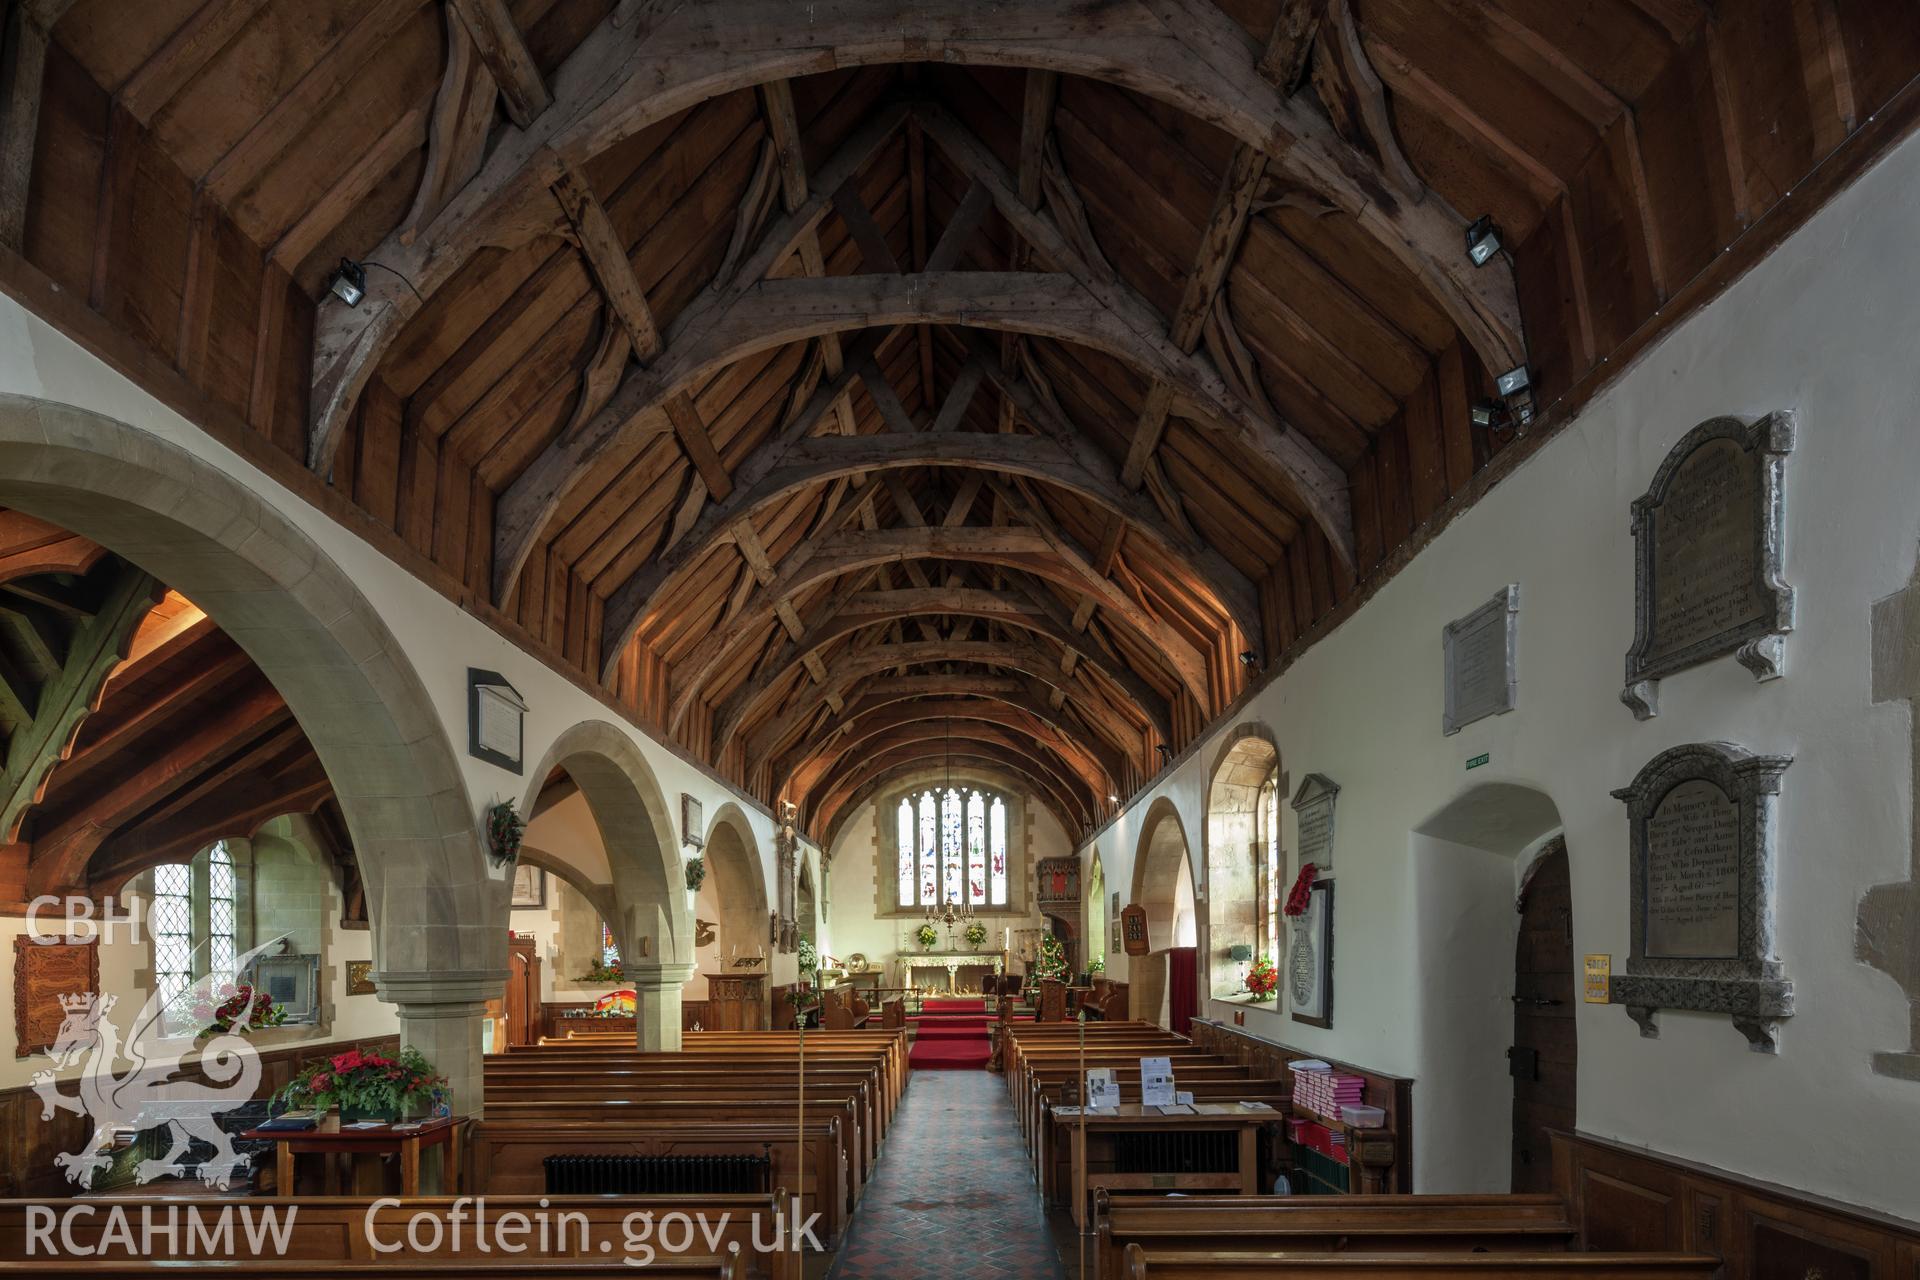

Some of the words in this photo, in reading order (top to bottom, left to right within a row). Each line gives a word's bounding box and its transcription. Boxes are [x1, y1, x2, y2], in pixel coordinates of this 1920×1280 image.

[1663, 804, 1671, 815] In
[1673, 800, 1707, 815] Memory
[1671, 858, 1689, 869] Who
[1692, 853, 1728, 869] Departed
[1680, 868, 1704, 880] March
[1672, 881, 1692, 893] Aged
